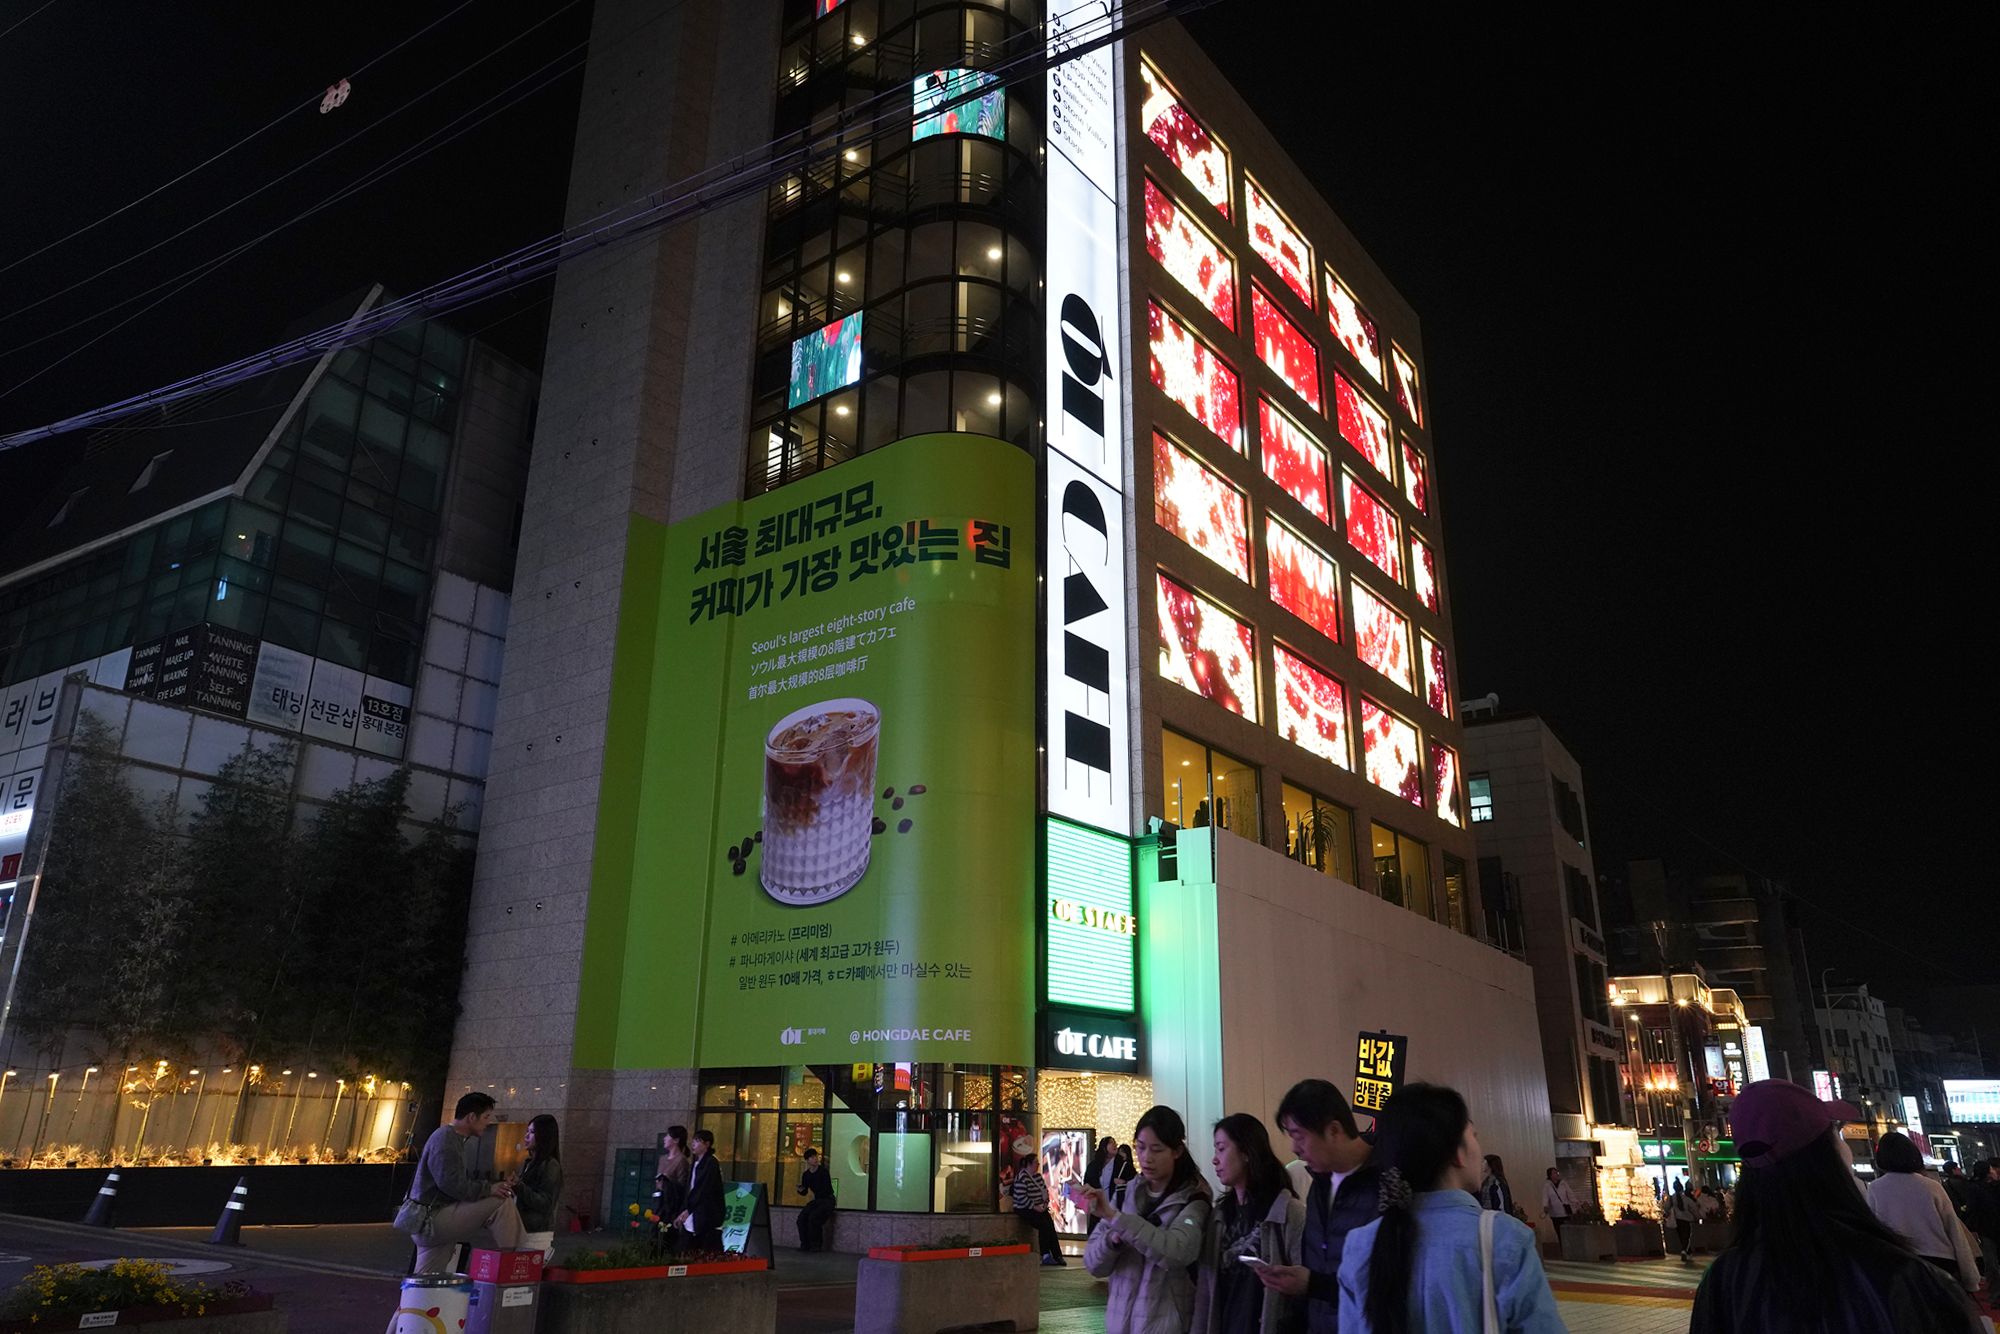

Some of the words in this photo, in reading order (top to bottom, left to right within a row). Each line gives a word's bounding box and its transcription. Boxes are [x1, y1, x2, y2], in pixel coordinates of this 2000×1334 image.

[694, 525, 748, 575] 서울
[755, 480, 883, 558] 최대규모,
[689, 568, 774, 625] 커피가
[780, 545, 842, 602] 가장
[848, 519, 960, 581] 맛있는
[973, 519, 1011, 570] 집
[751, 633, 787, 655] Seoul's
[789, 622, 825, 645] largest
[826, 606, 887, 633] eight-story
[889, 596, 916, 614] cafe
[208, 632, 254, 656] TANNING
[750, 626, 897, 677] ソウル最大規模の8階建てカフェ
[1061, 480, 1112, 805] CAFE
[164, 653, 183, 667] MAKE
[201, 661, 248, 685] TANNING
[209, 651, 245, 670] WHITE
[209, 682, 234, 696] SELF
[747, 655, 869, 701] 首尔最大规模的8层咖啡厅
[195, 690, 242, 711] TANNING
[272, 687, 304, 715] 태닝
[310, 698, 357, 729] 전문샵
[367, 699, 404, 721] 13호점
[361, 715, 383, 733] 홍대
[384, 722, 405, 739] 본점
[741, 928, 785, 945] 아메리카노
[788, 923, 832, 943] (프리미엄)
[739, 953, 793, 969] 파나마게이샤
[796, 948, 819, 964] (세계
[820, 943, 849, 961] 최고급
[851, 941, 872, 957] 고가
[873, 940, 900, 956] 원두)
[739, 975, 757, 990] 일반
[758, 973, 776, 989] 원두
[779, 971, 801, 987] 10배
[802, 969, 823, 986] 가격,
[901, 962, 941, 979] 마실수
[944, 962, 973, 979] 있는
[862, 1028, 930, 1042] HONGDAE
[932, 1028, 971, 1041] CAFE
[1088, 1033, 1136, 1060] CAFE
[1359, 1039, 1395, 1079] 반값
